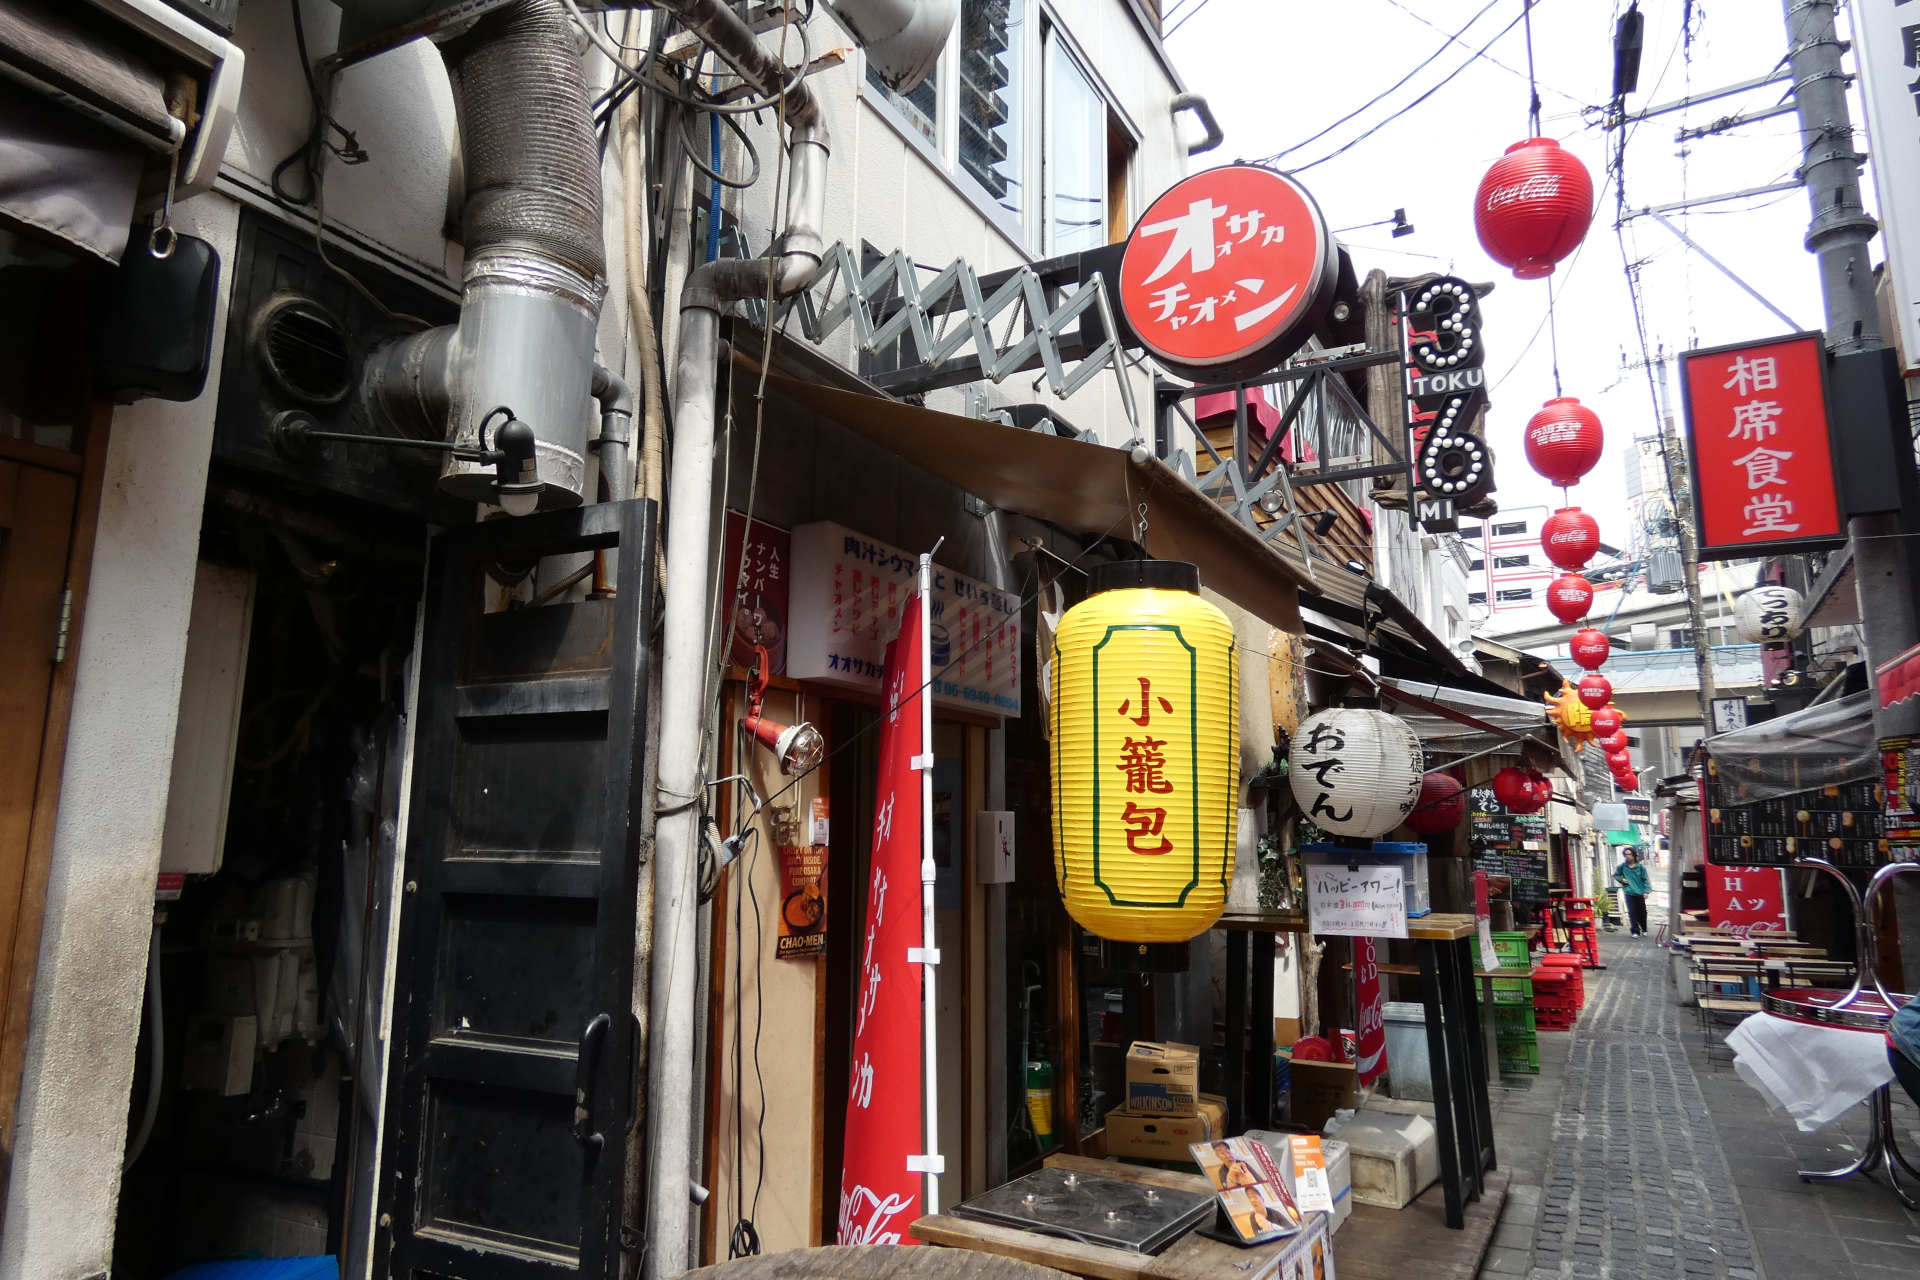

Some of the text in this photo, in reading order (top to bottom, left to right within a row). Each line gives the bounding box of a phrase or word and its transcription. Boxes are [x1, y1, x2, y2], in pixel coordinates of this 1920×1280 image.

[1487, 174, 1563, 211] Coca-Cola
[1149, 278, 1298, 331] チャオメン
[1413, 368, 1484, 396] TOKU
[1722, 355, 1800, 538] 相席食堂
[1420, 500, 1453, 521] MI
[768, 546, 780, 580] 人生
[1116, 677, 1174, 856] 小籠包
[1301, 723, 1354, 822] おでん
[1478, 798, 1500, 813] そら
[786, 856, 802, 866] JUICY
[788, 865, 821, 876] PURE OSAKA
[780, 933, 824, 950] CHAO-MEN
[1130, 1095, 1172, 1111] WILKINSON
